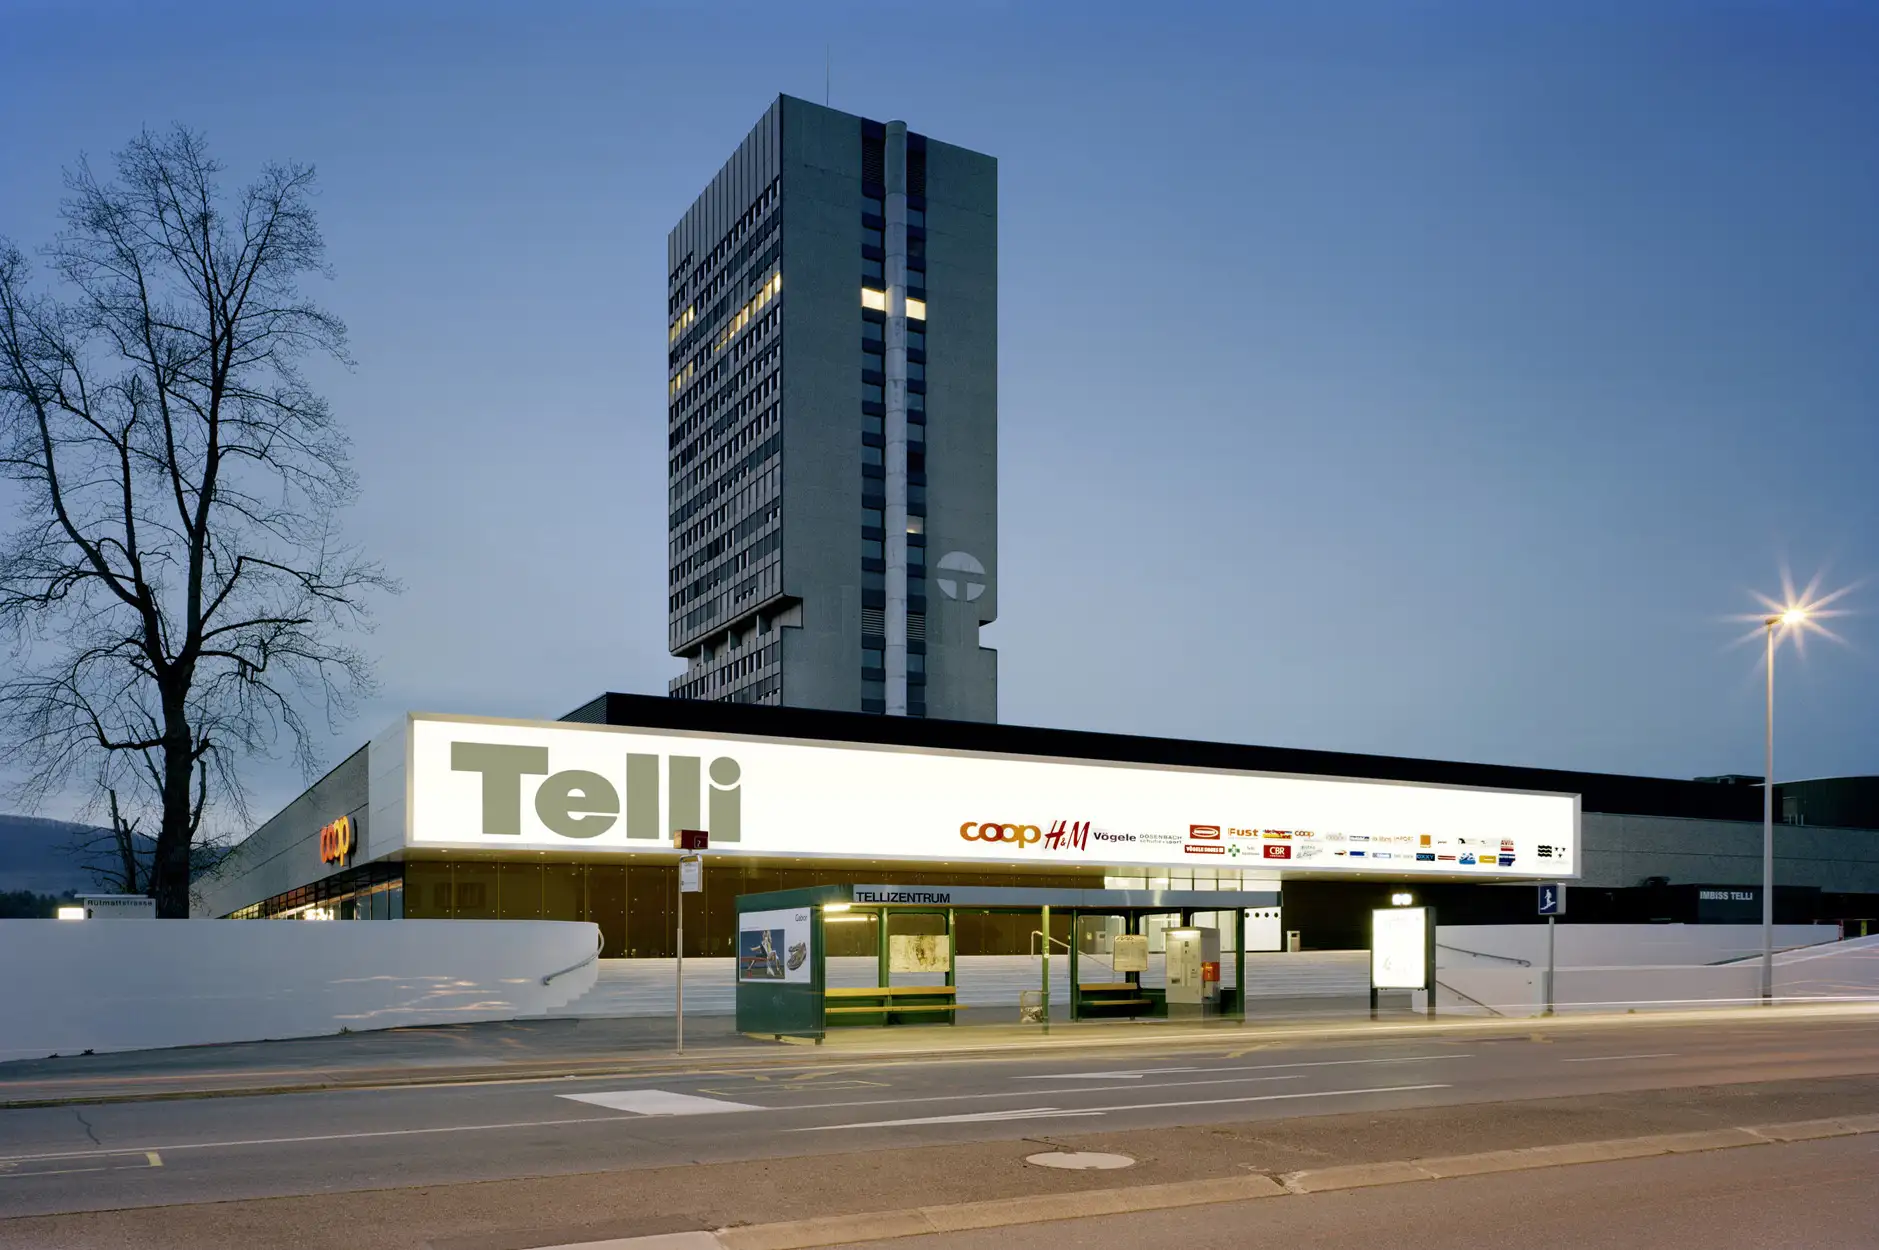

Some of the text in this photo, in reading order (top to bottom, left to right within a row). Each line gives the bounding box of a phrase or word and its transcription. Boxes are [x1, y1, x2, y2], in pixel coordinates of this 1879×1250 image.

[451, 741, 741, 842] Telli
[960, 821, 1041, 848] coop
[1044, 820, 1090, 851] H&M
[1093, 832, 1136, 843] Vögele
[1228, 828, 1259, 837] Fust
[1294, 830, 1315, 838] coop
[320, 815, 350, 867] coop
[1269, 846, 1285, 855] CBR
[856, 892, 950, 904] TELLIZENTRUM
[1730, 891, 1753, 901] TELLI
